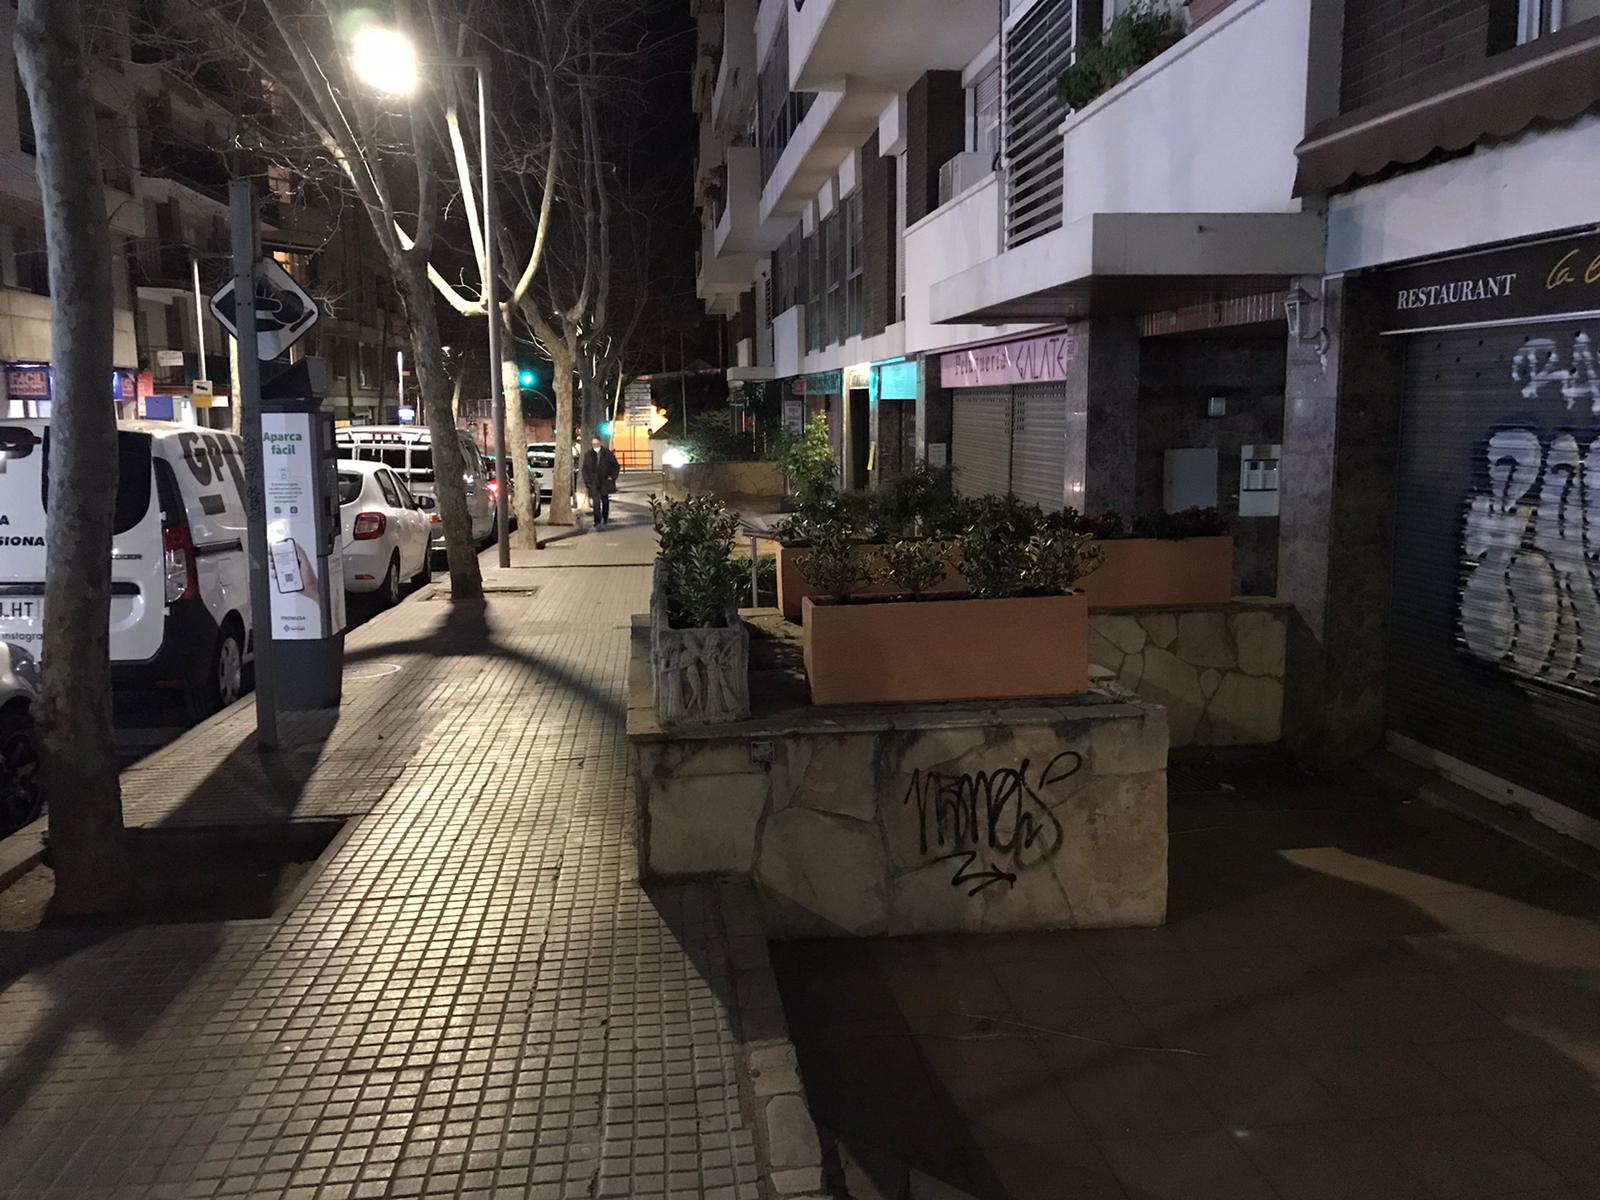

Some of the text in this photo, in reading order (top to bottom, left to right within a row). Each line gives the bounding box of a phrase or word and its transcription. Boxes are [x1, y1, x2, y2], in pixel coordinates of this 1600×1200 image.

[1397, 273, 1516, 310] RESTAURANT
[263, 432, 303, 443] Aparca
[0, 536, 45, 547] SIONA
